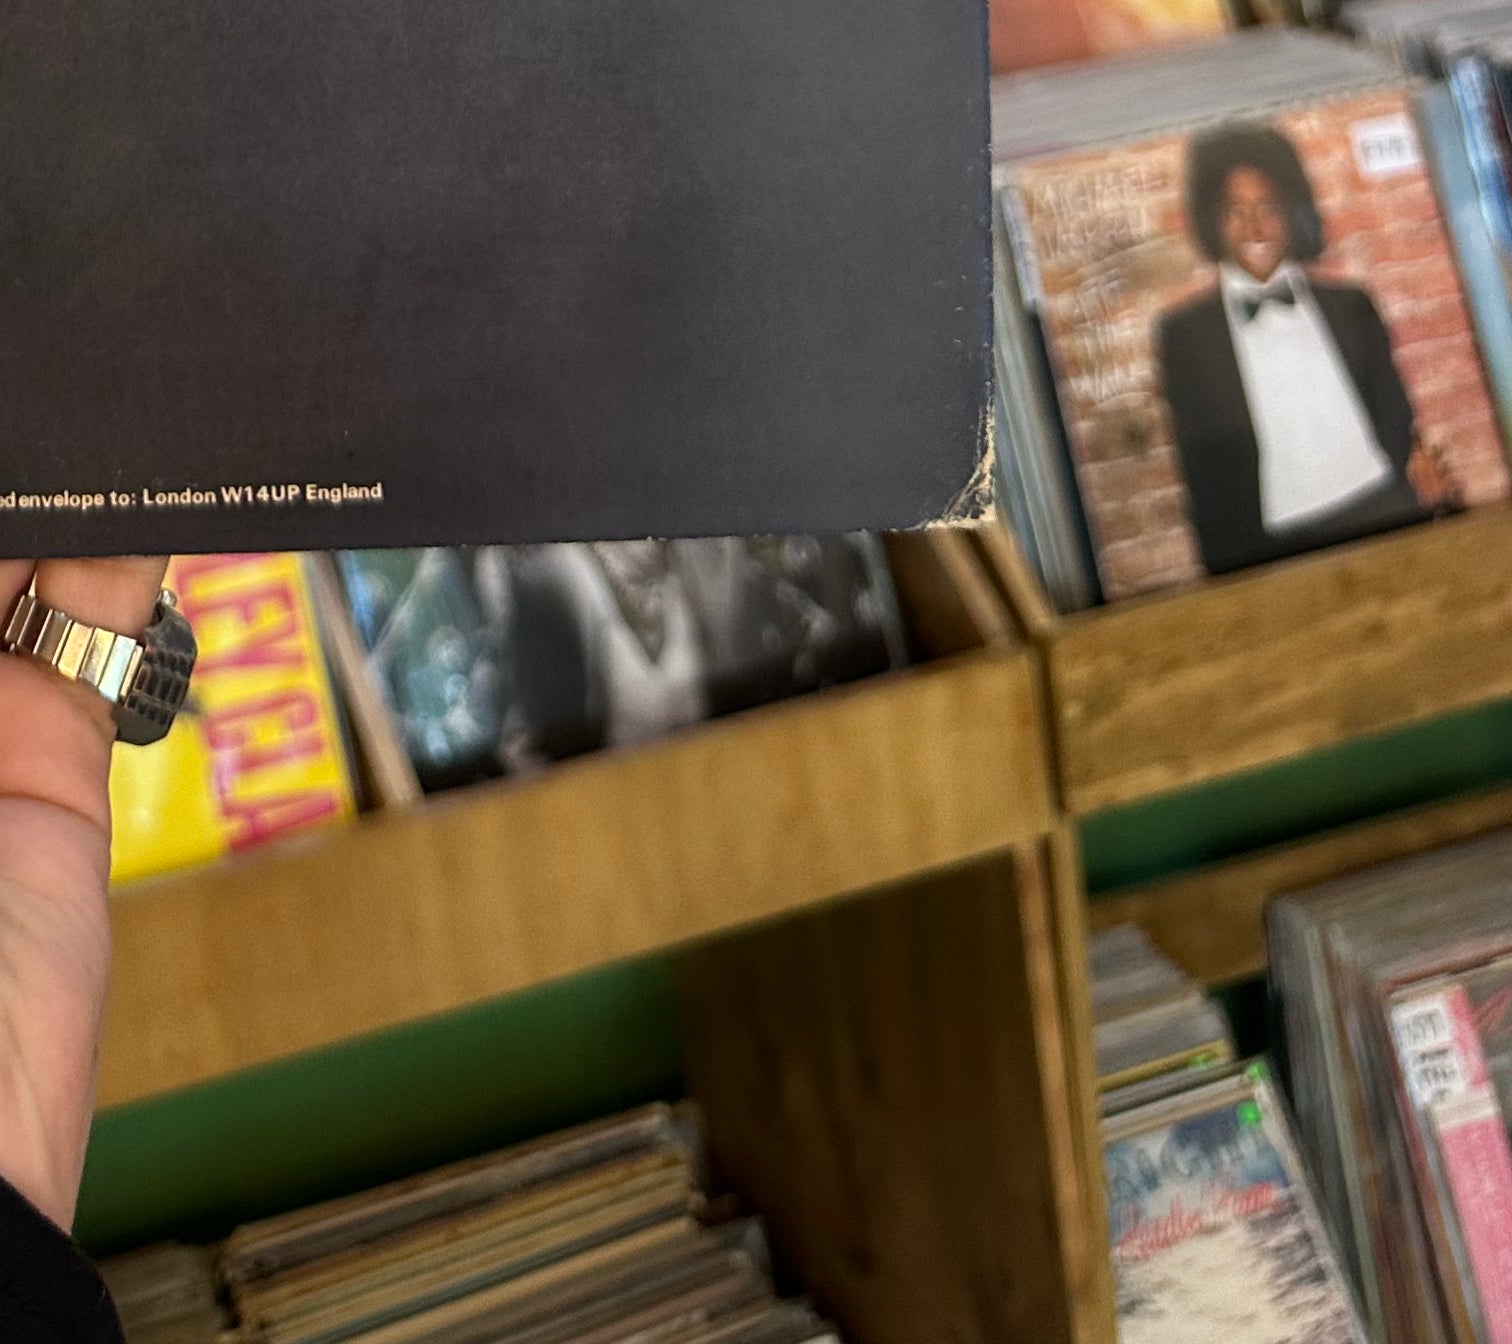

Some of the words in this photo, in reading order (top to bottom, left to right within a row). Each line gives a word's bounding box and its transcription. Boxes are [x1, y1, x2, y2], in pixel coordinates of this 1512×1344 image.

[18, 490, 105, 511] envelope
[109, 490, 137, 506] to:
[142, 487, 217, 505] London
[305, 482, 383, 504] England
[201, 690, 340, 855] CLA
